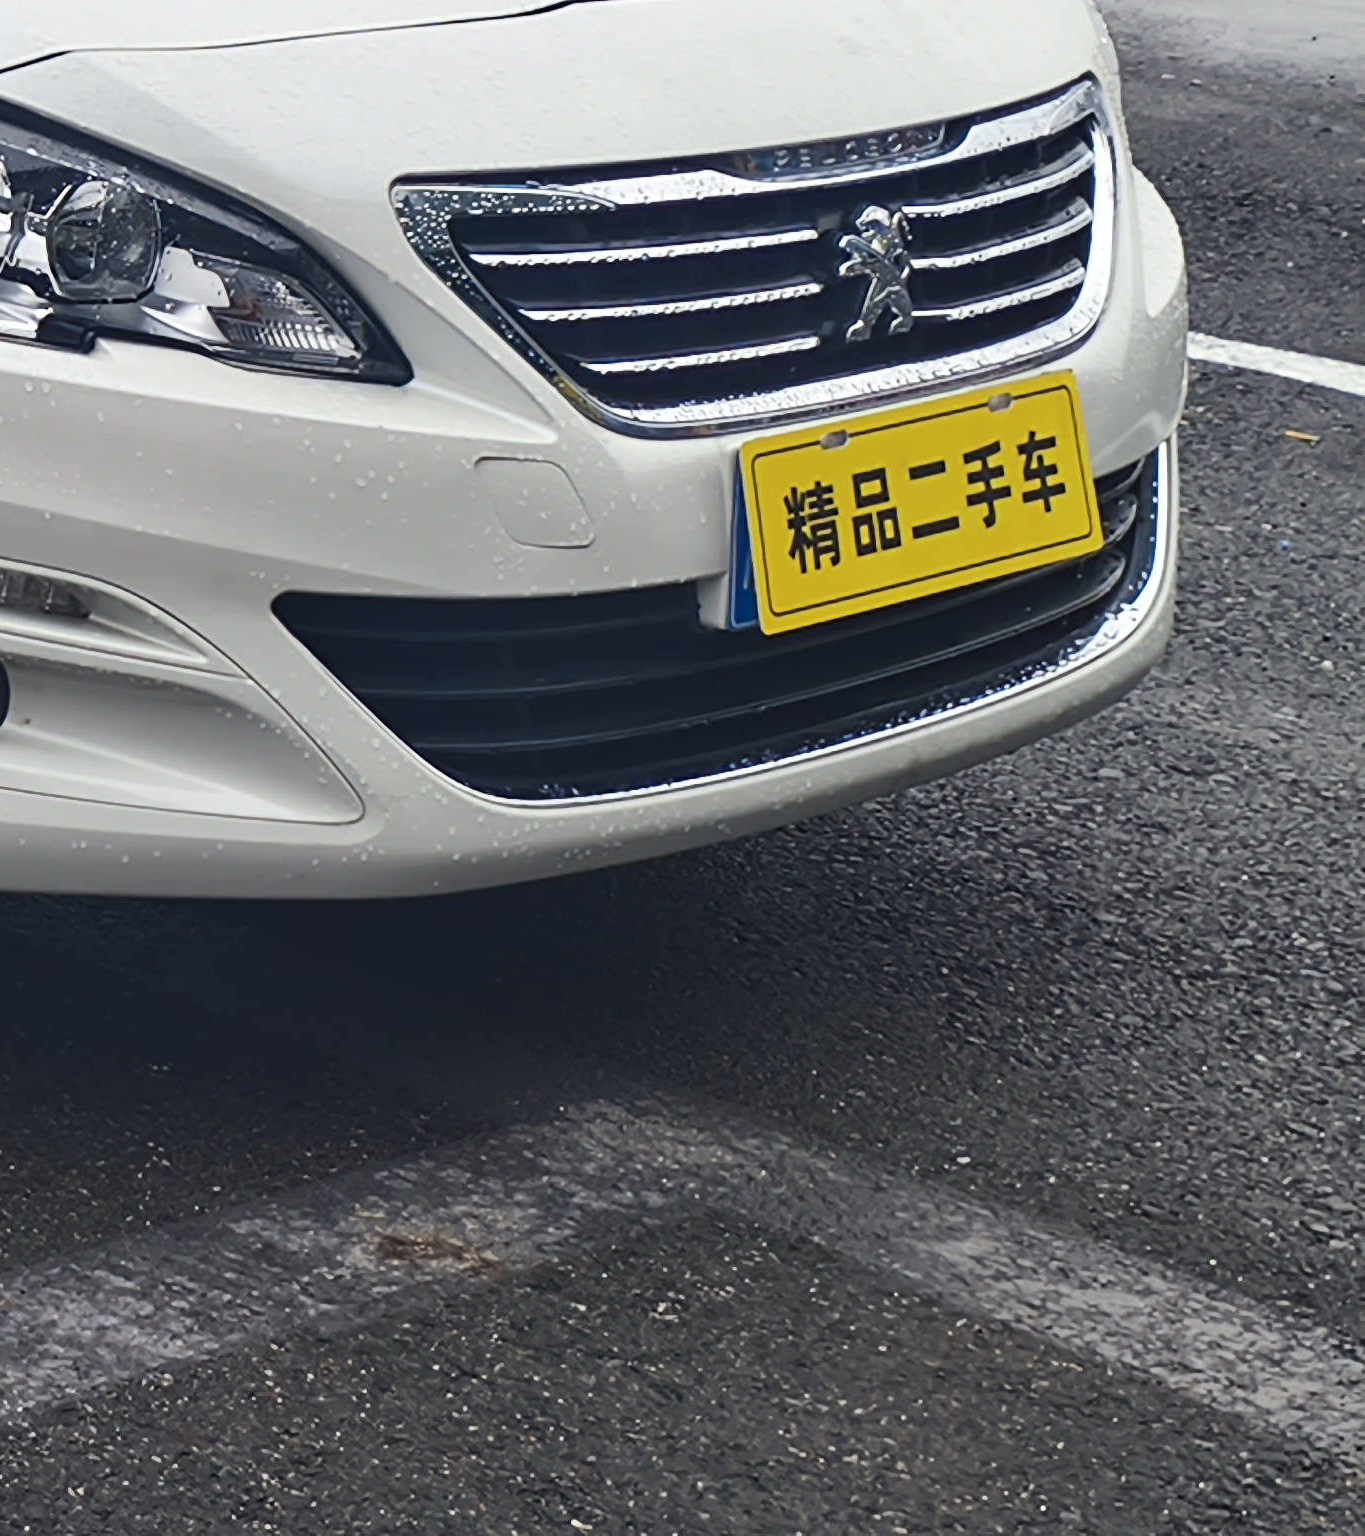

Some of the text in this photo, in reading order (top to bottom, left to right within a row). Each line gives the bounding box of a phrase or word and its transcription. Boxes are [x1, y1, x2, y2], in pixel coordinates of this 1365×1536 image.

[782, 429, 1067, 574] 精品二手车
